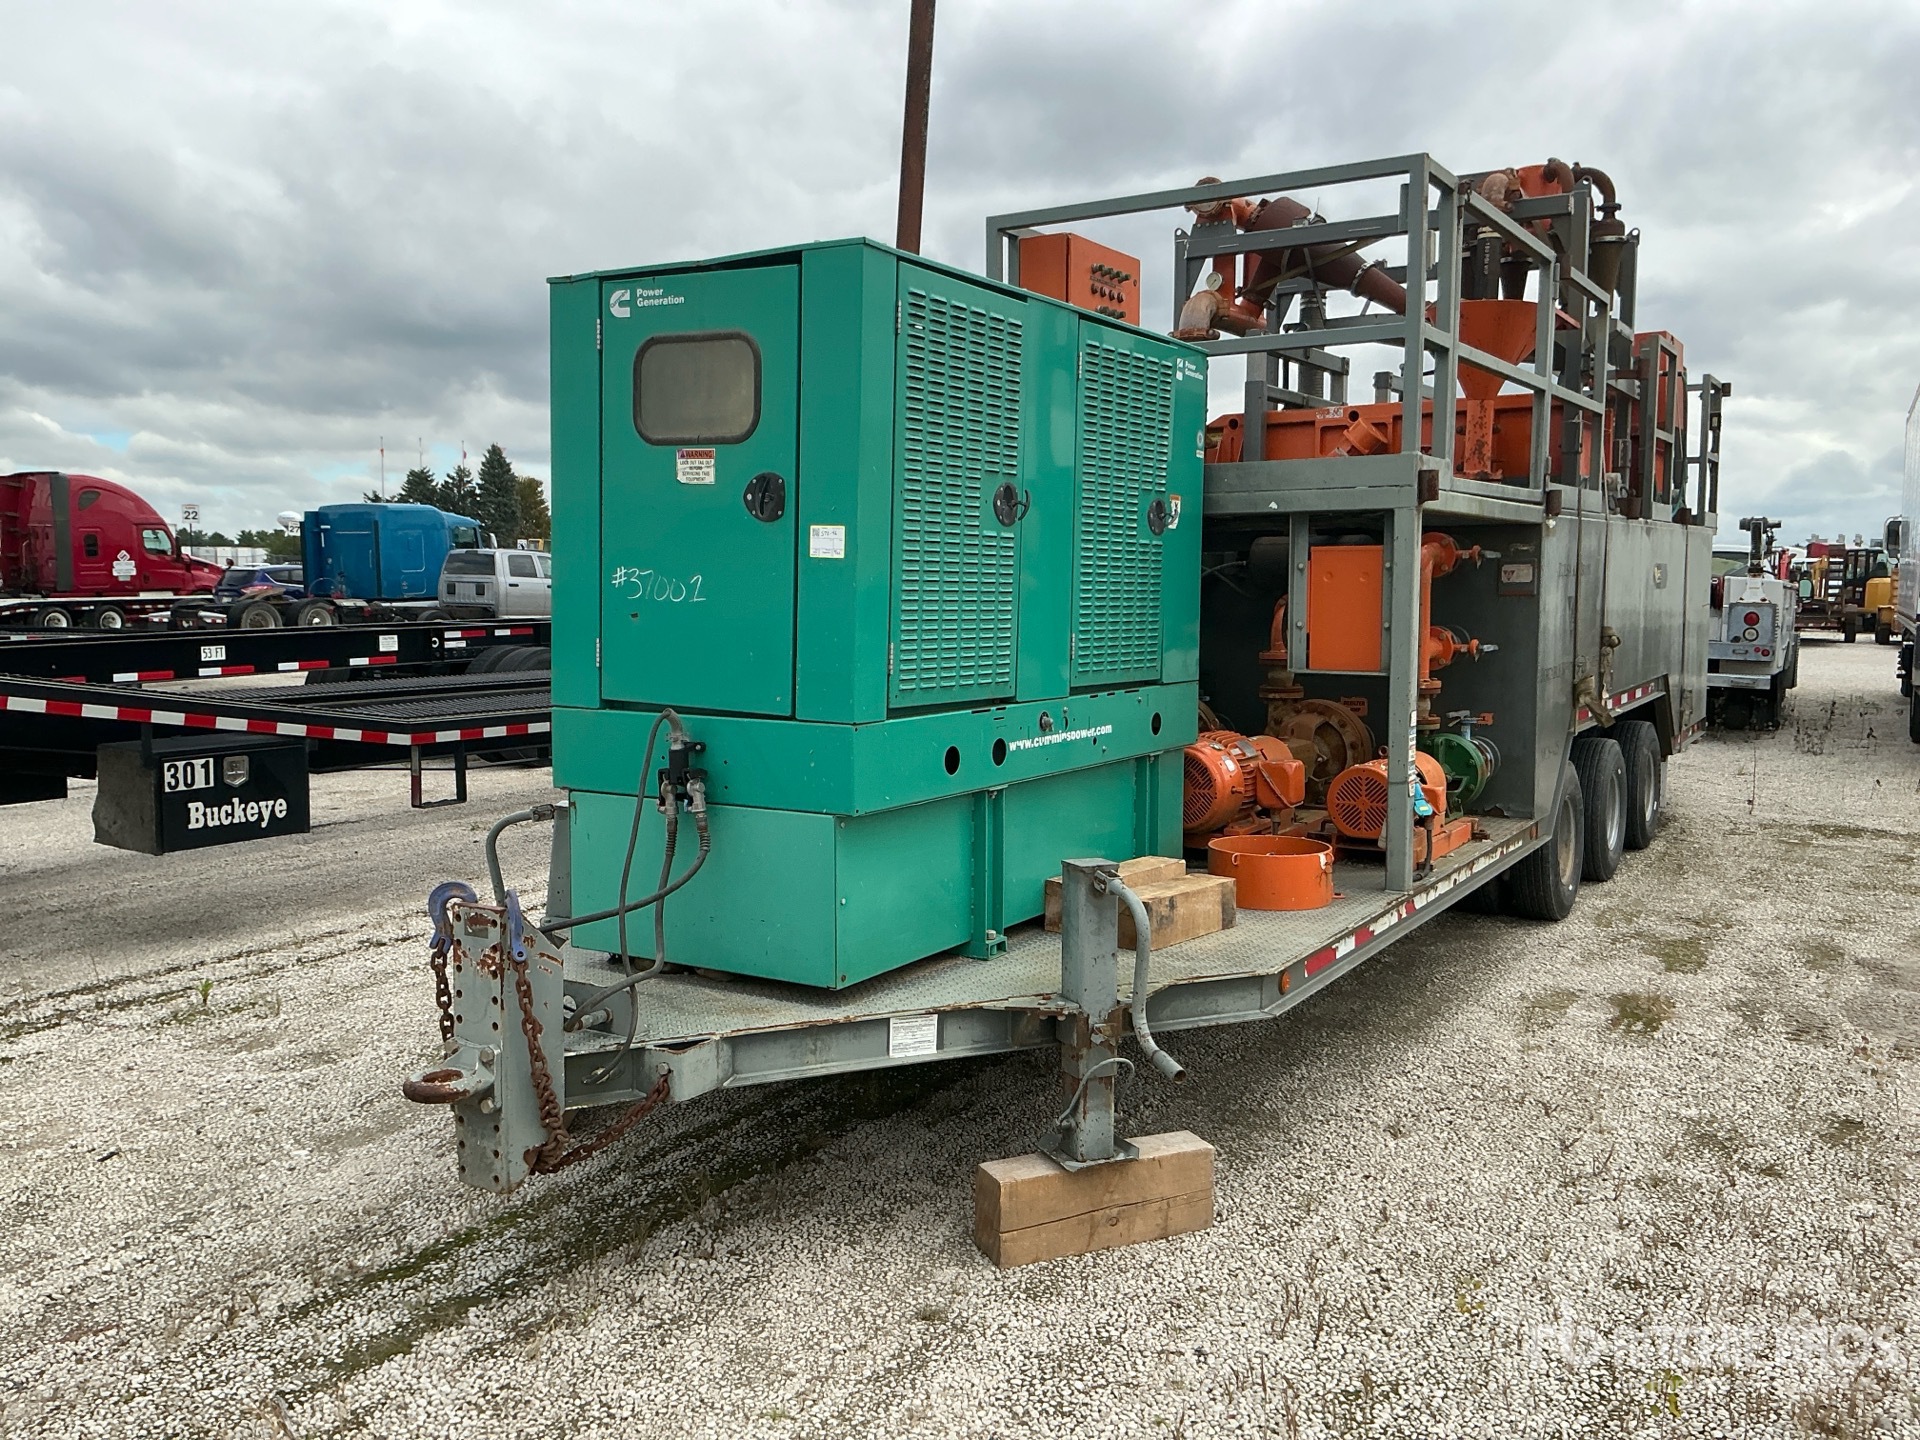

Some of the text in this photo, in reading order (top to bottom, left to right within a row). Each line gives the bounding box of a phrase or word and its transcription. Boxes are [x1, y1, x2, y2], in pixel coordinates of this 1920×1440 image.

[636, 288, 663, 297] Power
[637, 295, 685, 307] Generation
[685, 450, 712, 458] WARNING
[183, 510, 198, 520] 22
[289, 525, 300, 533] 27
[203, 647, 223, 659] 53 FT
[166, 760, 211, 790] 301
[187, 797, 287, 829] Buckeye
